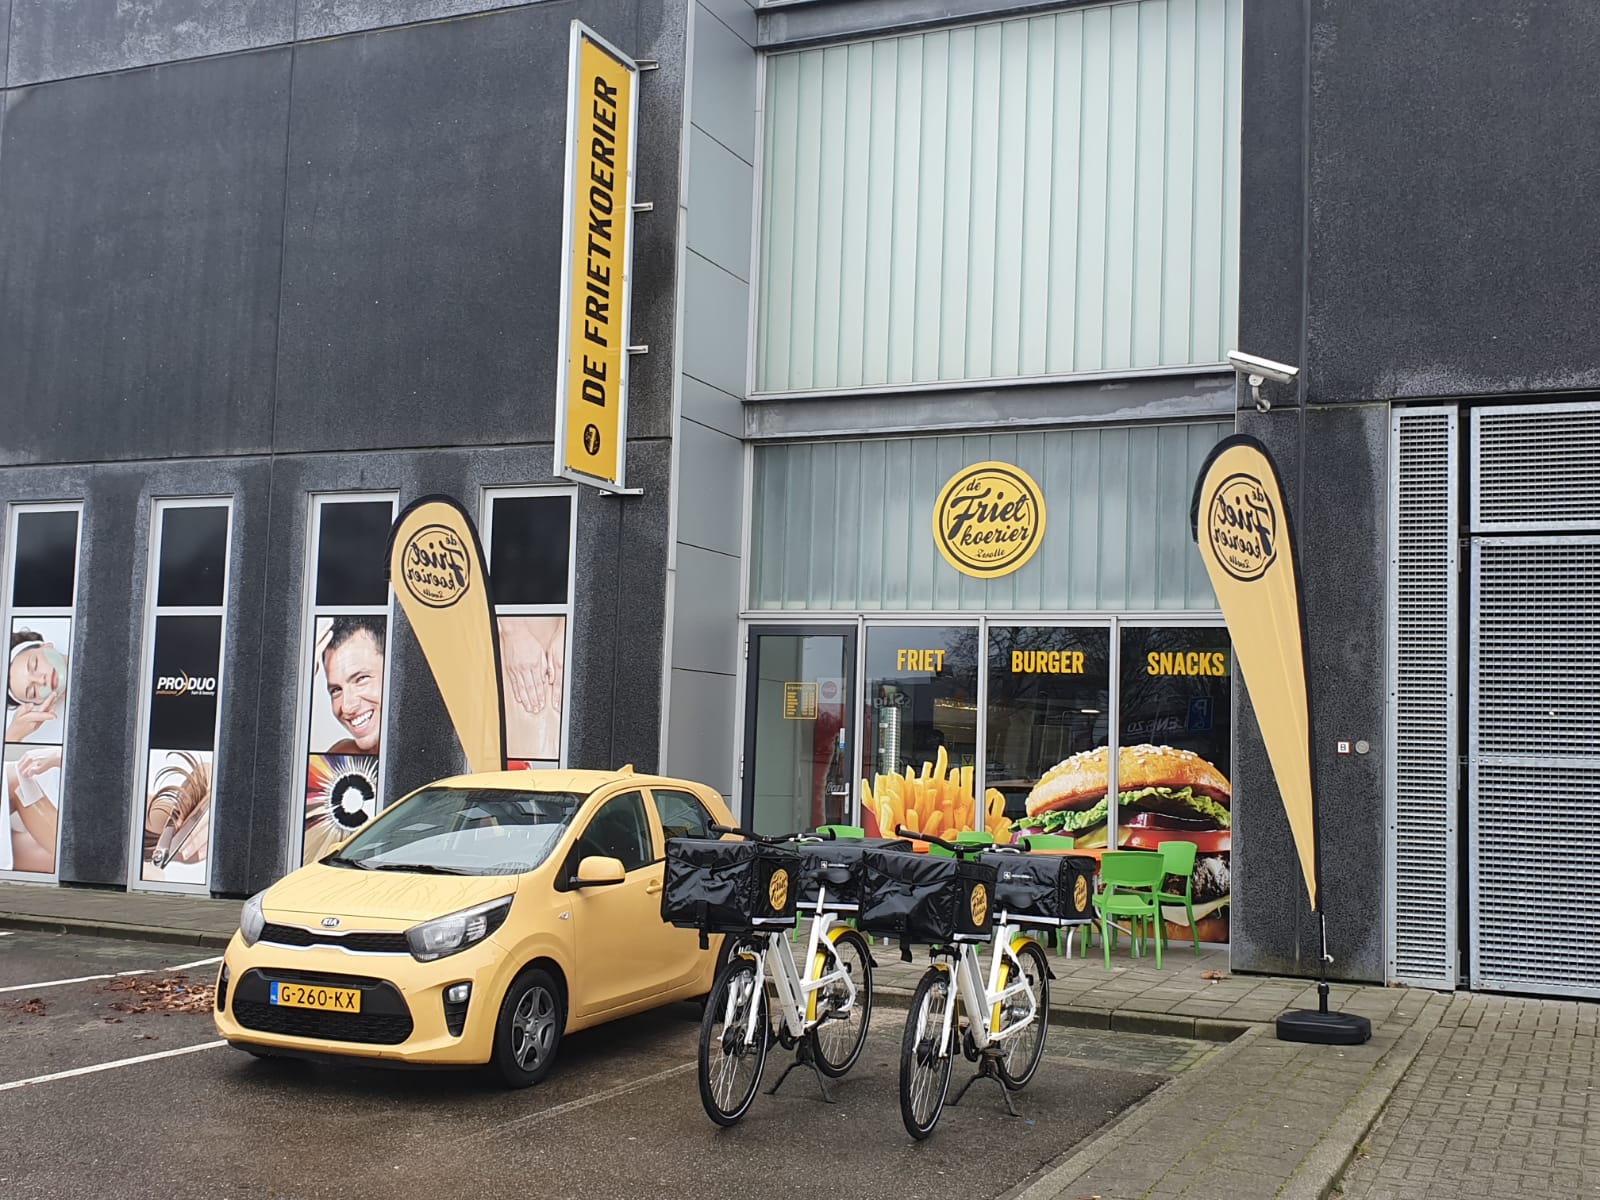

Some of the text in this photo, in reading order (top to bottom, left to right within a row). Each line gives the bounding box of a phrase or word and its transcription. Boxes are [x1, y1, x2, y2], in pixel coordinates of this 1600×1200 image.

[584, 76, 617, 348] FRIETKOERIER
[582, 354, 607, 407] DE
[966, 478, 981, 491] de
[948, 487, 1030, 541] Friet
[960, 525, 1030, 547] koerier
[897, 649, 946, 672] FRIET
[1011, 650, 1085, 675] BURGER
[1147, 651, 1225, 676] SNACKS
[323, 918, 338, 926] KIA
[281, 986, 355, 1009] G-260-KX
